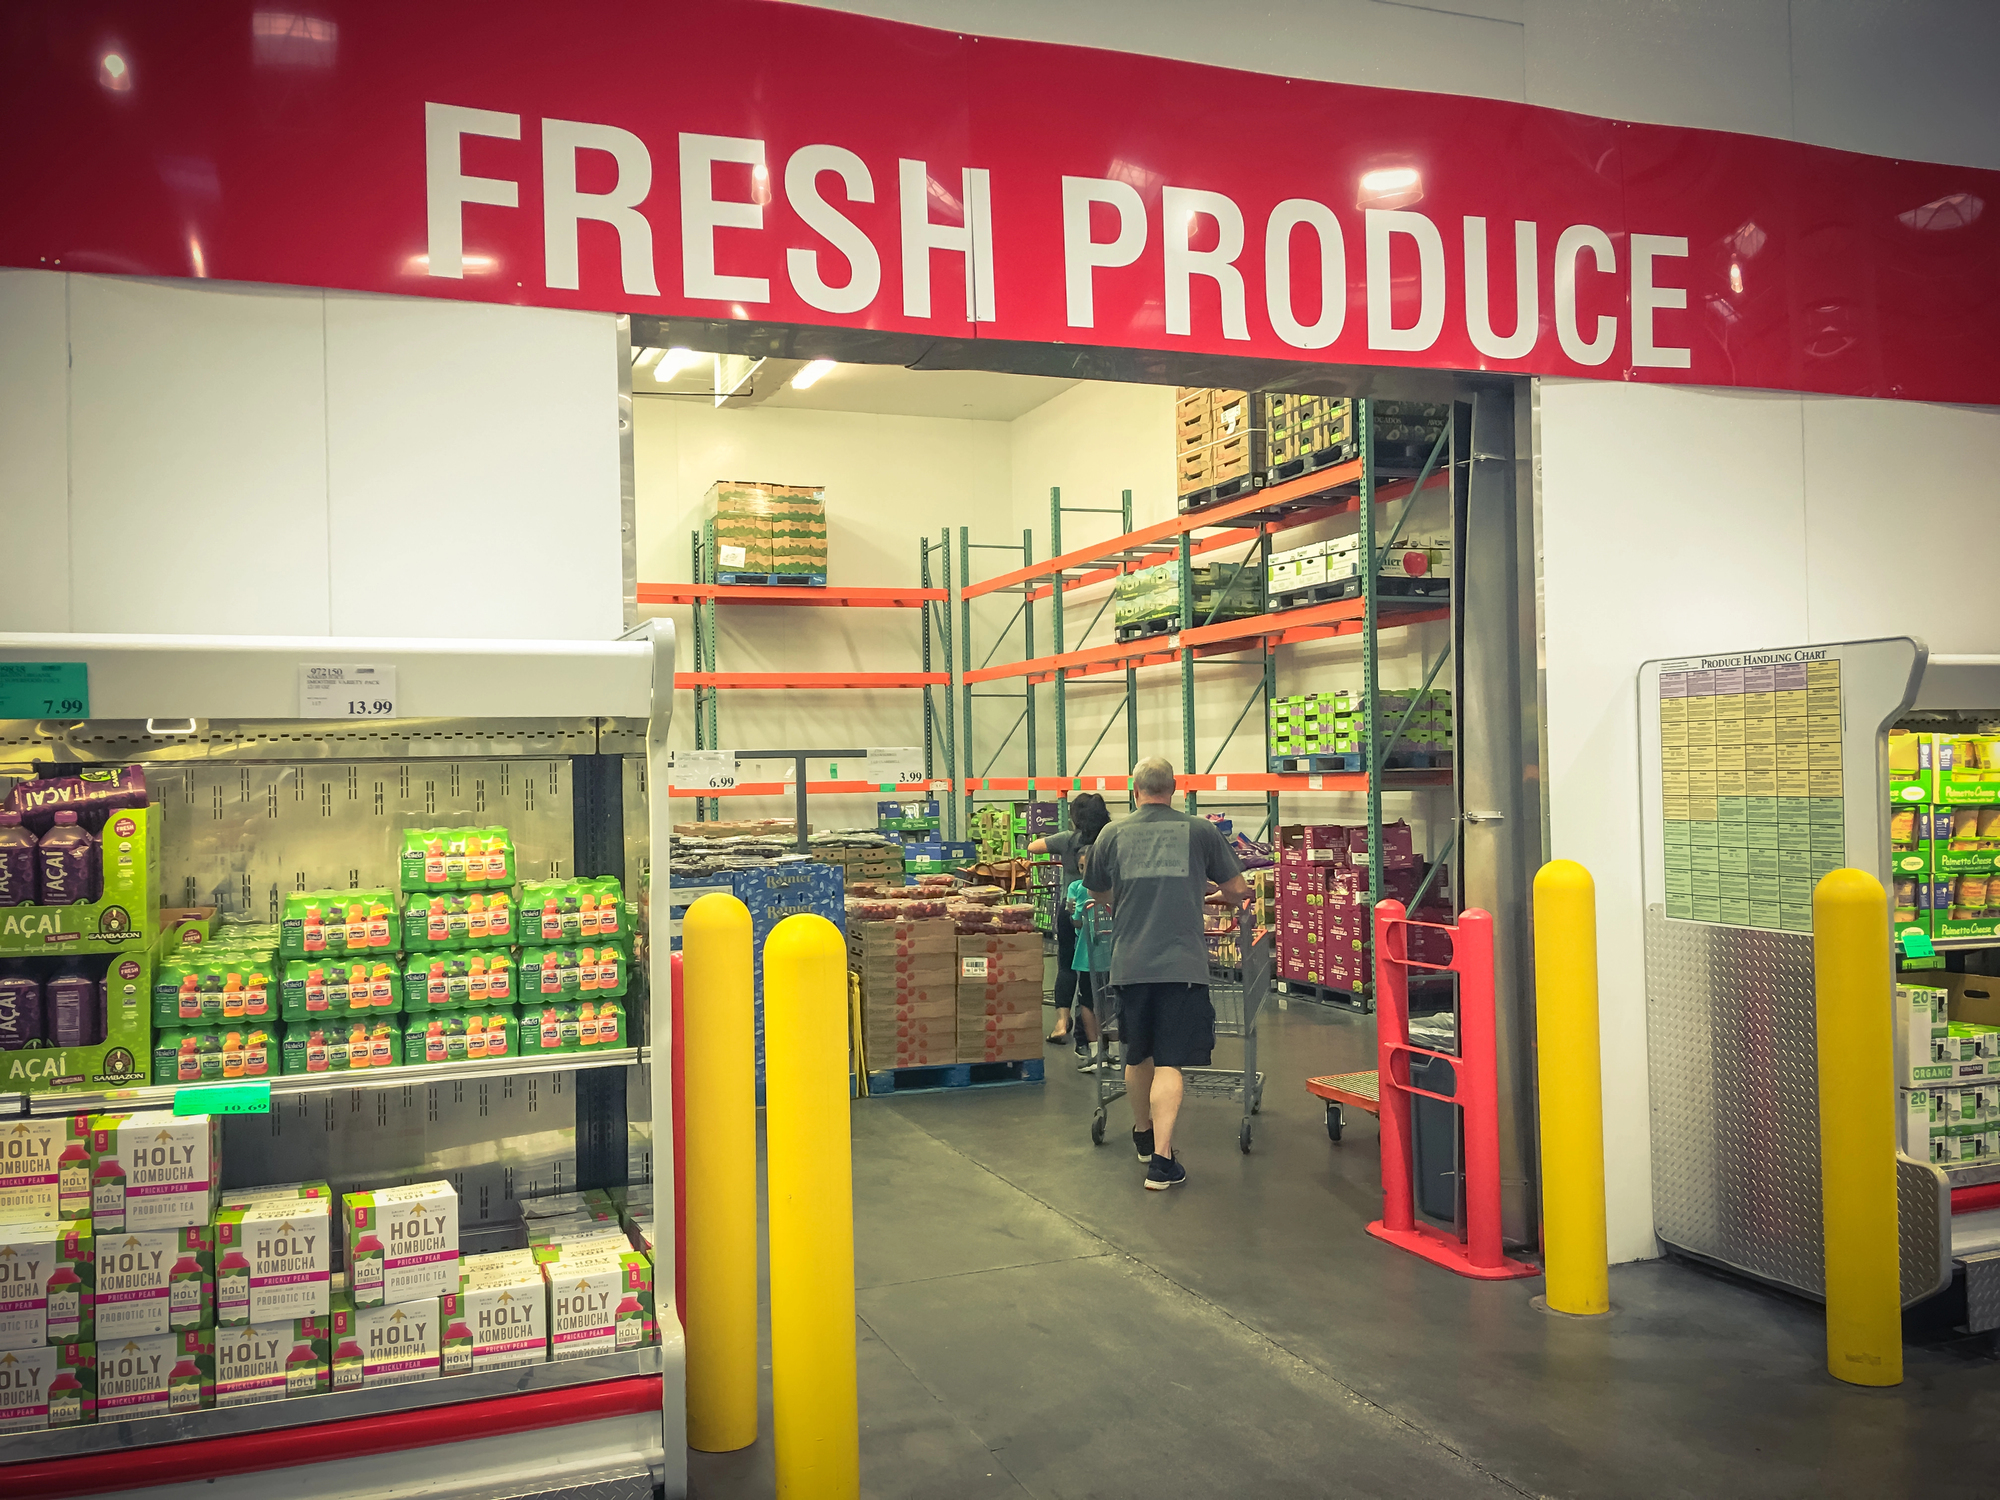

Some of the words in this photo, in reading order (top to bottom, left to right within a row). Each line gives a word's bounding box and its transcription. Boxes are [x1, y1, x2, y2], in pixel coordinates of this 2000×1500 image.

[424, 101, 995, 323] FRESH
[1061, 176, 1691, 370] PRODUCE
[1701, 659, 1741, 669] PRODUCE
[1743, 653, 1792, 666] HANDLING
[1794, 650, 1827, 661] CHART
[310, 668, 343, 676] 972150
[43, 700, 83, 714] 7.99
[348, 701, 393, 714] 13.99
[709, 777, 734, 787] 6.99
[899, 772, 922, 782] 3.99
[1945, 786, 1975, 797] Palmetto
[1942, 854, 1971, 865] Palmetto
[1971, 854, 1992, 865] Cheese
[42, 850, 68, 891] AÇAÍ
[766, 874, 812, 888] Rainier
[3, 909, 62, 938] AÇAÍ
[1942, 924, 1971, 935] Palmetto
[1971, 923, 1992, 934] Cheese
[88, 932, 140, 940] SAMBAZON
[1912, 991, 1929, 1004] 20
[9, 1052, 67, 1083] AÇAÍ
[1913, 1067, 1952, 1078] ORGANIC
[93, 1073, 144, 1082] SAMBAZON
[1911, 1091, 1926, 1105] 20
[224, 1103, 267, 1111] 10.69
[78, 1118, 84, 1128] 6
[98, 1133, 104, 1144] 6
[133, 1145, 195, 1168] HOLY
[0, 1159, 51, 1174] OMBUCHA
[133, 1166, 194, 1183] KOMBUCHA
[0, 1177, 25, 1186] RICKLY
[63, 1177, 87, 1186] HOLY
[141, 1186, 169, 1194] PRICKLY
[1, 1195, 34, 1206] OBIOTIC
[37, 1194, 51, 1202] TEA
[96, 1194, 121, 1203] HOLY
[133, 1203, 176, 1215] PROBIOTIC
[180, 1202, 194, 1211] TEA
[358, 1210, 364, 1220] 6
[223, 1226, 229, 1236] 6
[391, 1216, 446, 1240] HOLY
[190, 1229, 196, 1240] 6
[68, 1240, 74, 1250] 6
[257, 1235, 316, 1258] HOLY
[391, 1236, 446, 1256] KOMBUCHA
[101, 1251, 163, 1274] HOLY
[257, 1256, 315, 1274] KOMBUCHA
[397, 1256, 423, 1266] PRICKLY
[0, 1261, 40, 1283] OLY
[357, 1267, 380, 1278] HOLY
[631, 1271, 637, 1280] 6
[101, 1272, 162, 1290] KOMBUCHA
[264, 1276, 290, 1284] PRICKLY
[391, 1273, 430, 1287] PROBIOTIC
[434, 1270, 446, 1280] TEA
[2, 1283, 39, 1299] BUCHA
[173, 1290, 198, 1299] HOLY
[222, 1286, 246, 1295] HOLY
[107, 1292, 135, 1301] PRICKLY
[257, 1293, 299, 1306] PROBIOTIC
[302, 1292, 315, 1301] TEA
[51, 1302, 76, 1311] HOLY
[447, 1298, 453, 1307] 6
[557, 1292, 609, 1316] HOLY
[101, 1309, 144, 1323] PROBIOTIC
[148, 1308, 162, 1317] TEA
[338, 1316, 344, 1326] 6
[479, 1304, 533, 1328] HOLY
[25, 1320, 39, 1329] TEA
[305, 1318, 311, 1328] 6
[557, 1312, 608, 1331] KOMBUCHA
[371, 1323, 427, 1347] HOLY
[479, 1325, 532, 1343] KOMBUCHA
[563, 1331, 587, 1340] PRICKLY
[589, 1329, 604, 1337] PEAR
[619, 1327, 639, 1337] HOLY
[188, 1333, 195, 1343] 6
[69, 1345, 75, 1356] 6
[220, 1340, 279, 1365] HOLY
[371, 1343, 426, 1362] KOMBUCHA
[486, 1344, 511, 1353] PRICKLY
[447, 1354, 469, 1363] HOLY
[101, 1355, 161, 1380] HOLY
[220, 1361, 278, 1380] KOMBUCHA
[377, 1362, 403, 1372] PRICKLY
[0, 1368, 40, 1389] OLY
[290, 1377, 314, 1387] HOLY
[337, 1374, 360, 1383] HOLY
[101, 1376, 161, 1395] KOMBUCHA
[227, 1381, 254, 1391] PRICKLY
[257, 1379, 273, 1387] PEAR
[0, 1389, 40, 1406] BUCHA
[107, 1396, 135, 1406] PRICKLY
[172, 1393, 197, 1403] HOLY
[53, 1407, 78, 1417] HOLY
